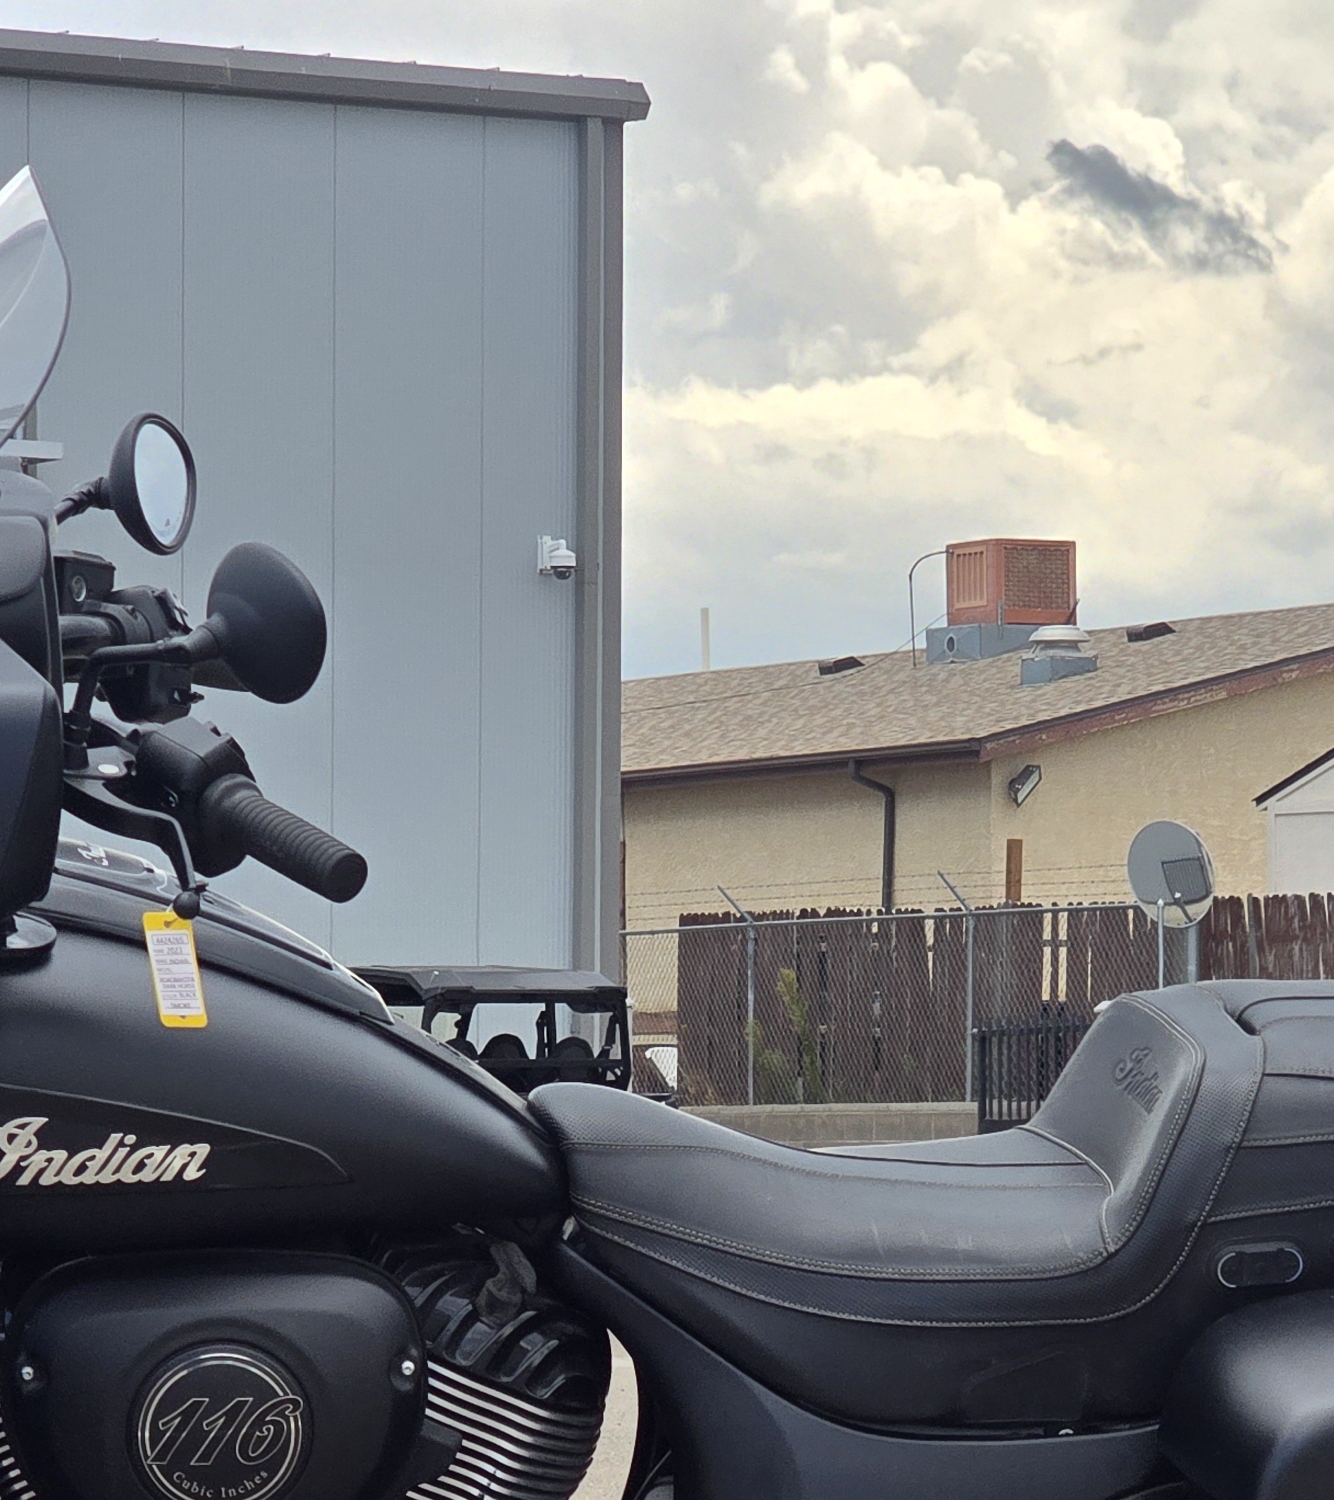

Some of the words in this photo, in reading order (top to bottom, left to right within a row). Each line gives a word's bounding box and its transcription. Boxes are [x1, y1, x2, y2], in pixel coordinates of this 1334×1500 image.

[147, 1395, 304, 1466] 116
[172, 1471, 214, 1498] Cubic
[221, 1470, 269, 1499] Inches
